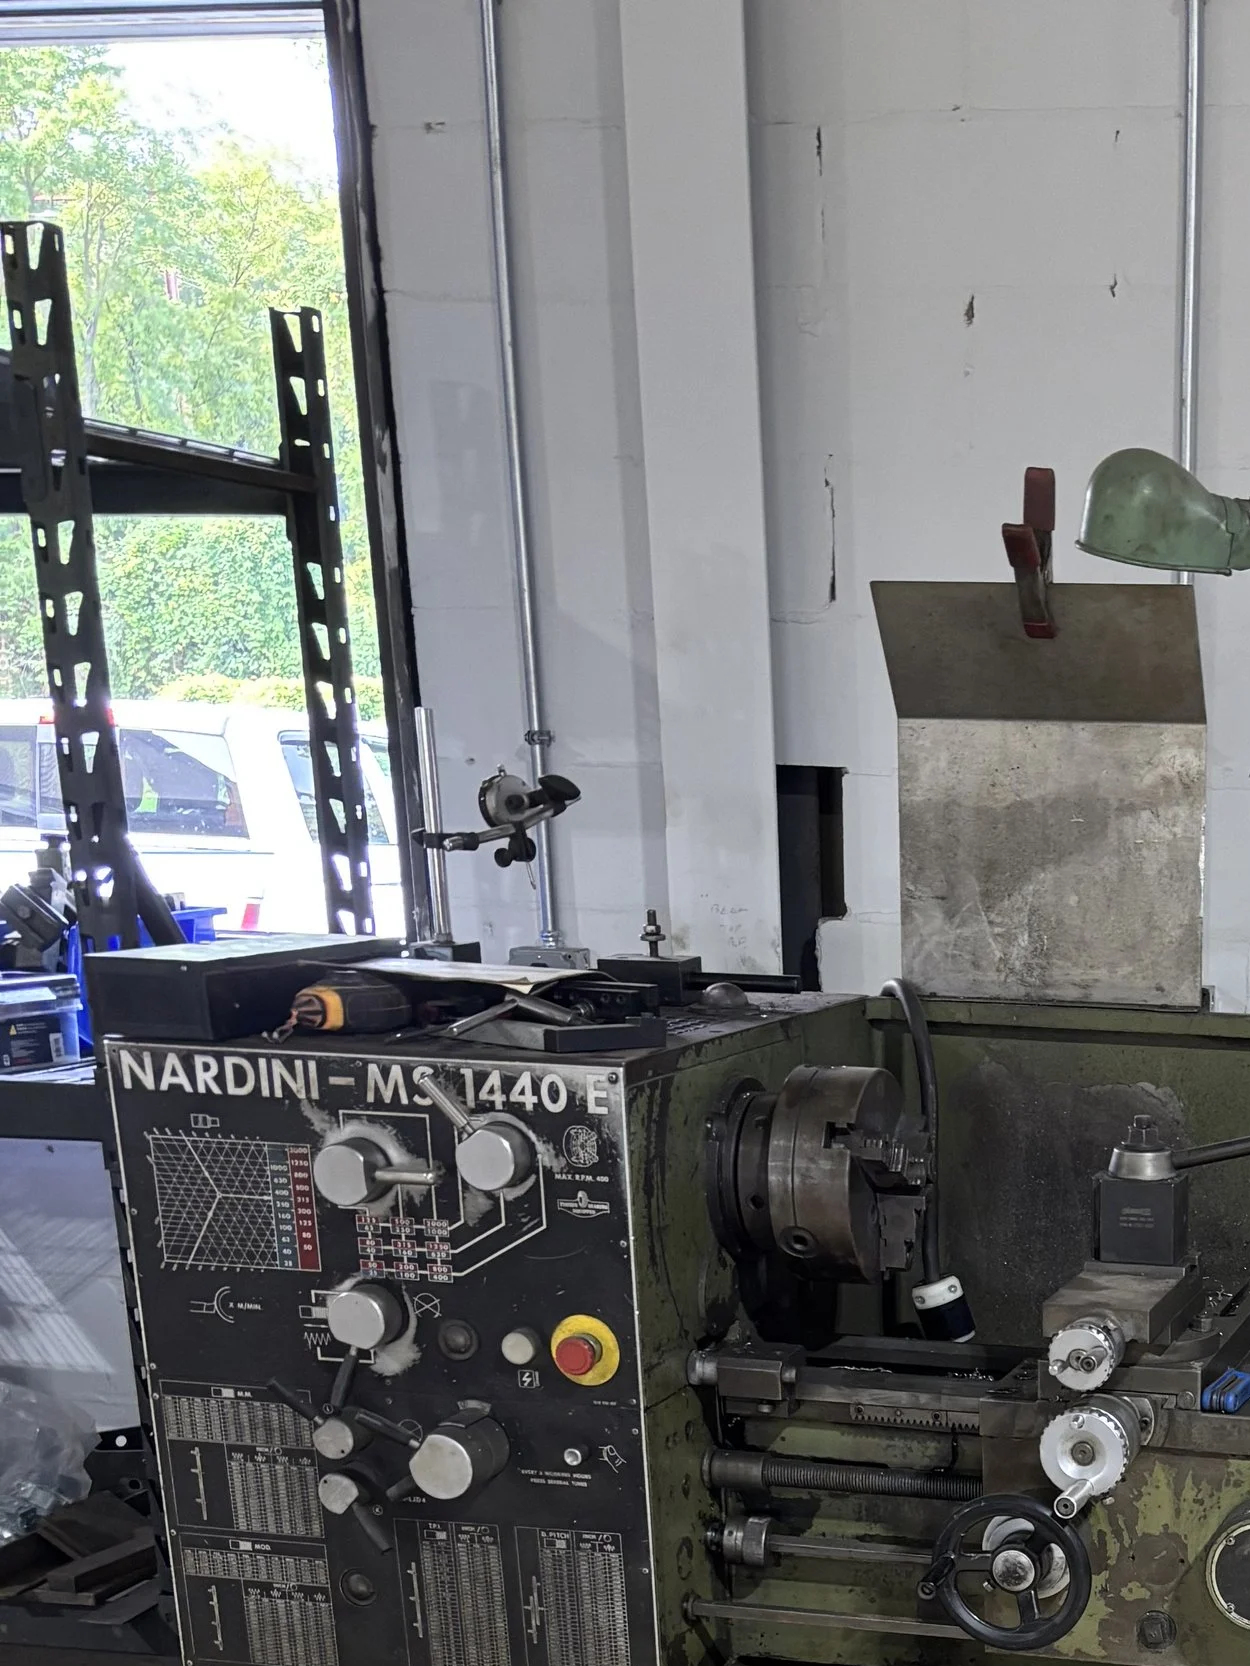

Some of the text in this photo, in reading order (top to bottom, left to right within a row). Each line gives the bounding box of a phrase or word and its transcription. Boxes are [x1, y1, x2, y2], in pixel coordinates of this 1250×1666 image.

[119, 1049, 320, 1100] NARDINI
[459, 1067, 568, 1113] 1440
[585, 1073, 609, 1115] E
